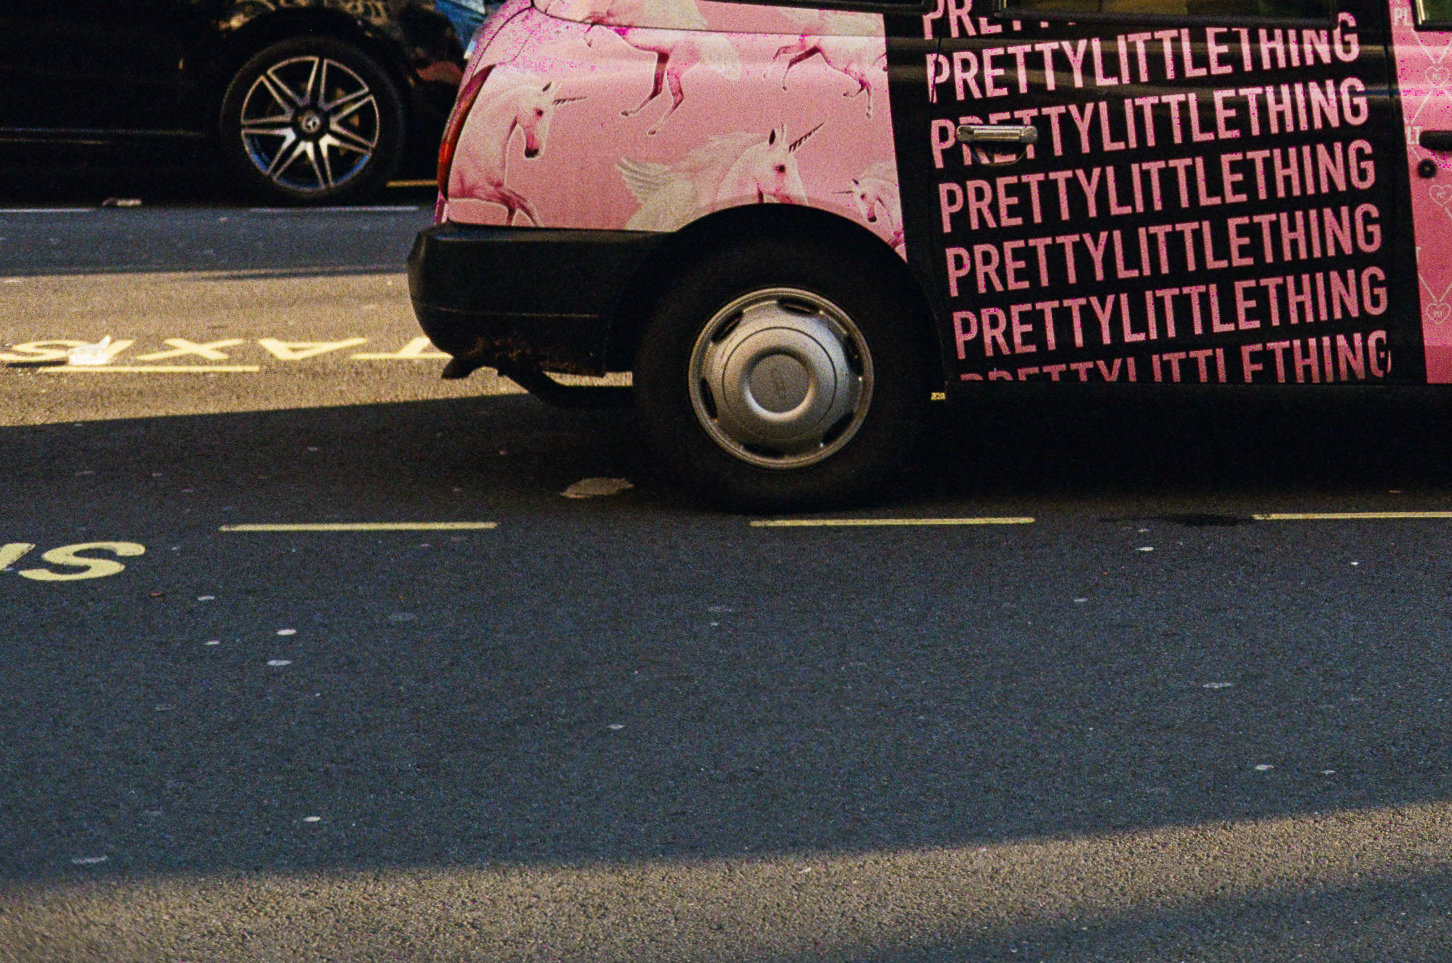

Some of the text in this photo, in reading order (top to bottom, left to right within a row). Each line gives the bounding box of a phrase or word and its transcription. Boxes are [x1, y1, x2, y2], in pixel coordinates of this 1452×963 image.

[925, 12, 1360, 103] PRETTYLITTLETHING
[938, 139, 1375, 233] PRETTYLITTLETHING
[945, 203, 1382, 297] PRETTYLITTLETHING
[952, 265, 1388, 359] PRETTYLITTLETHING
